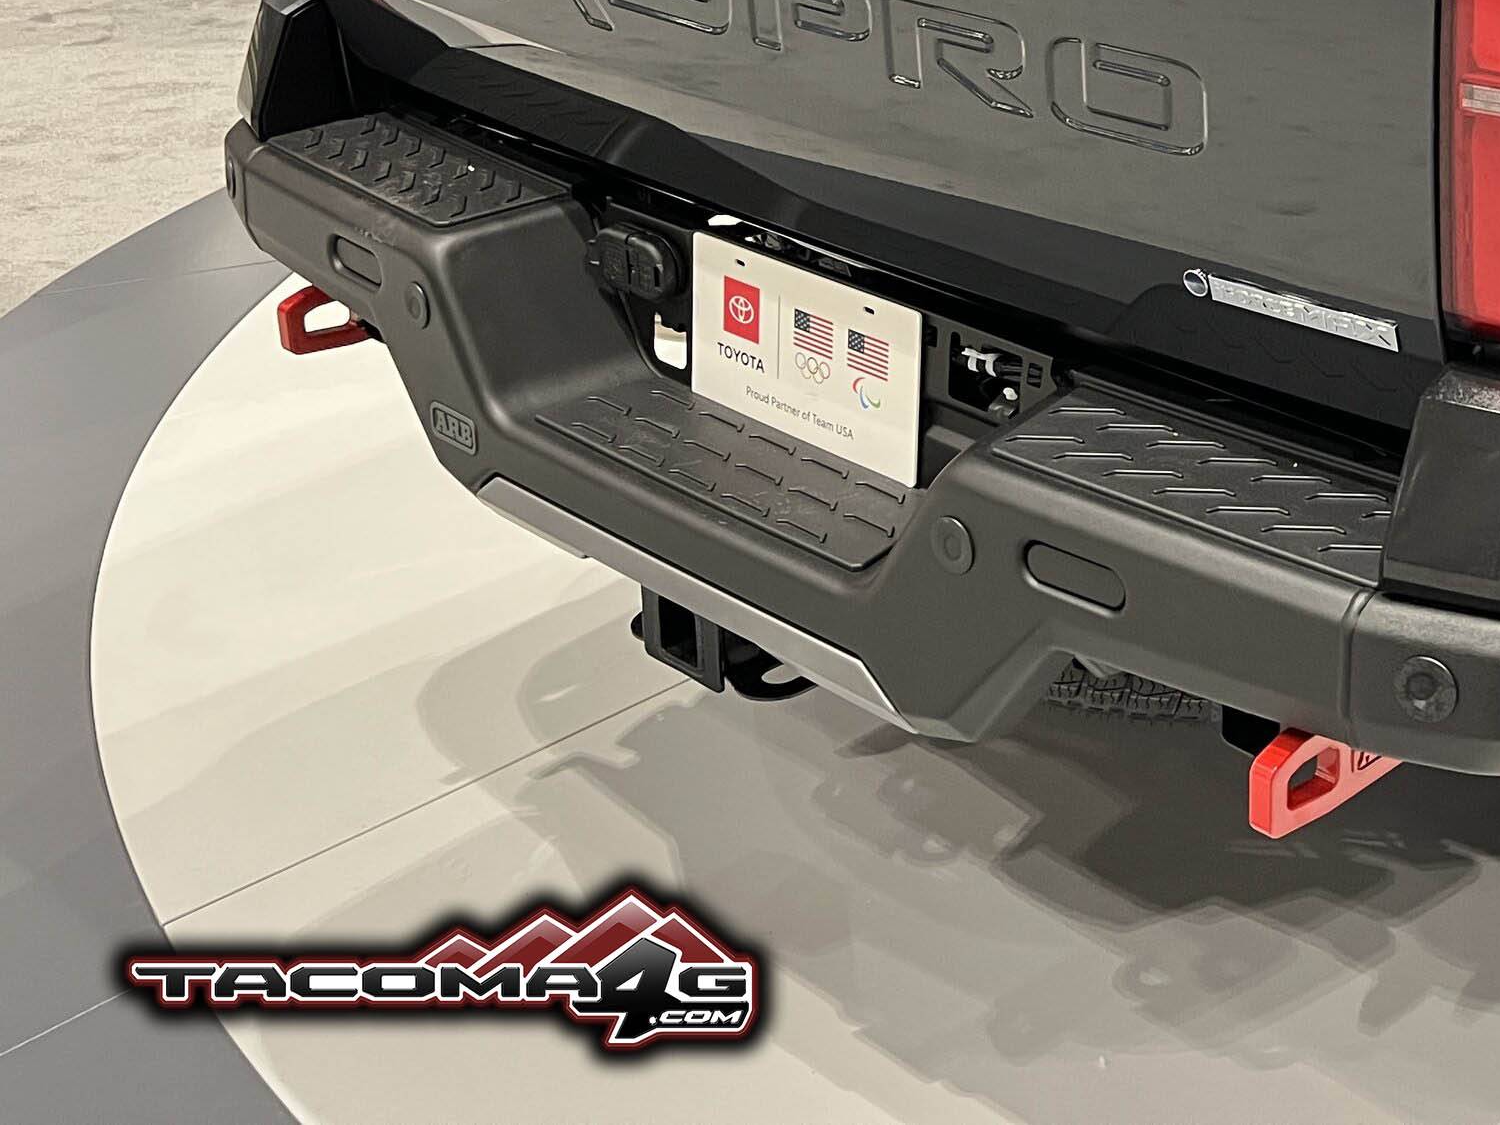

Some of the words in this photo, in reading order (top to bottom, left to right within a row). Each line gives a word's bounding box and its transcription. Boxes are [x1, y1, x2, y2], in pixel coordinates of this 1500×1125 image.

[717, 341, 765, 373] TOYOTA
[433, 408, 474, 450] ARB
[746, 385, 770, 404] Proud
[771, 396, 801, 418] Partner
[802, 410, 811, 422] of
[812, 413, 834, 432] Team
[836, 423, 855, 441] USA
